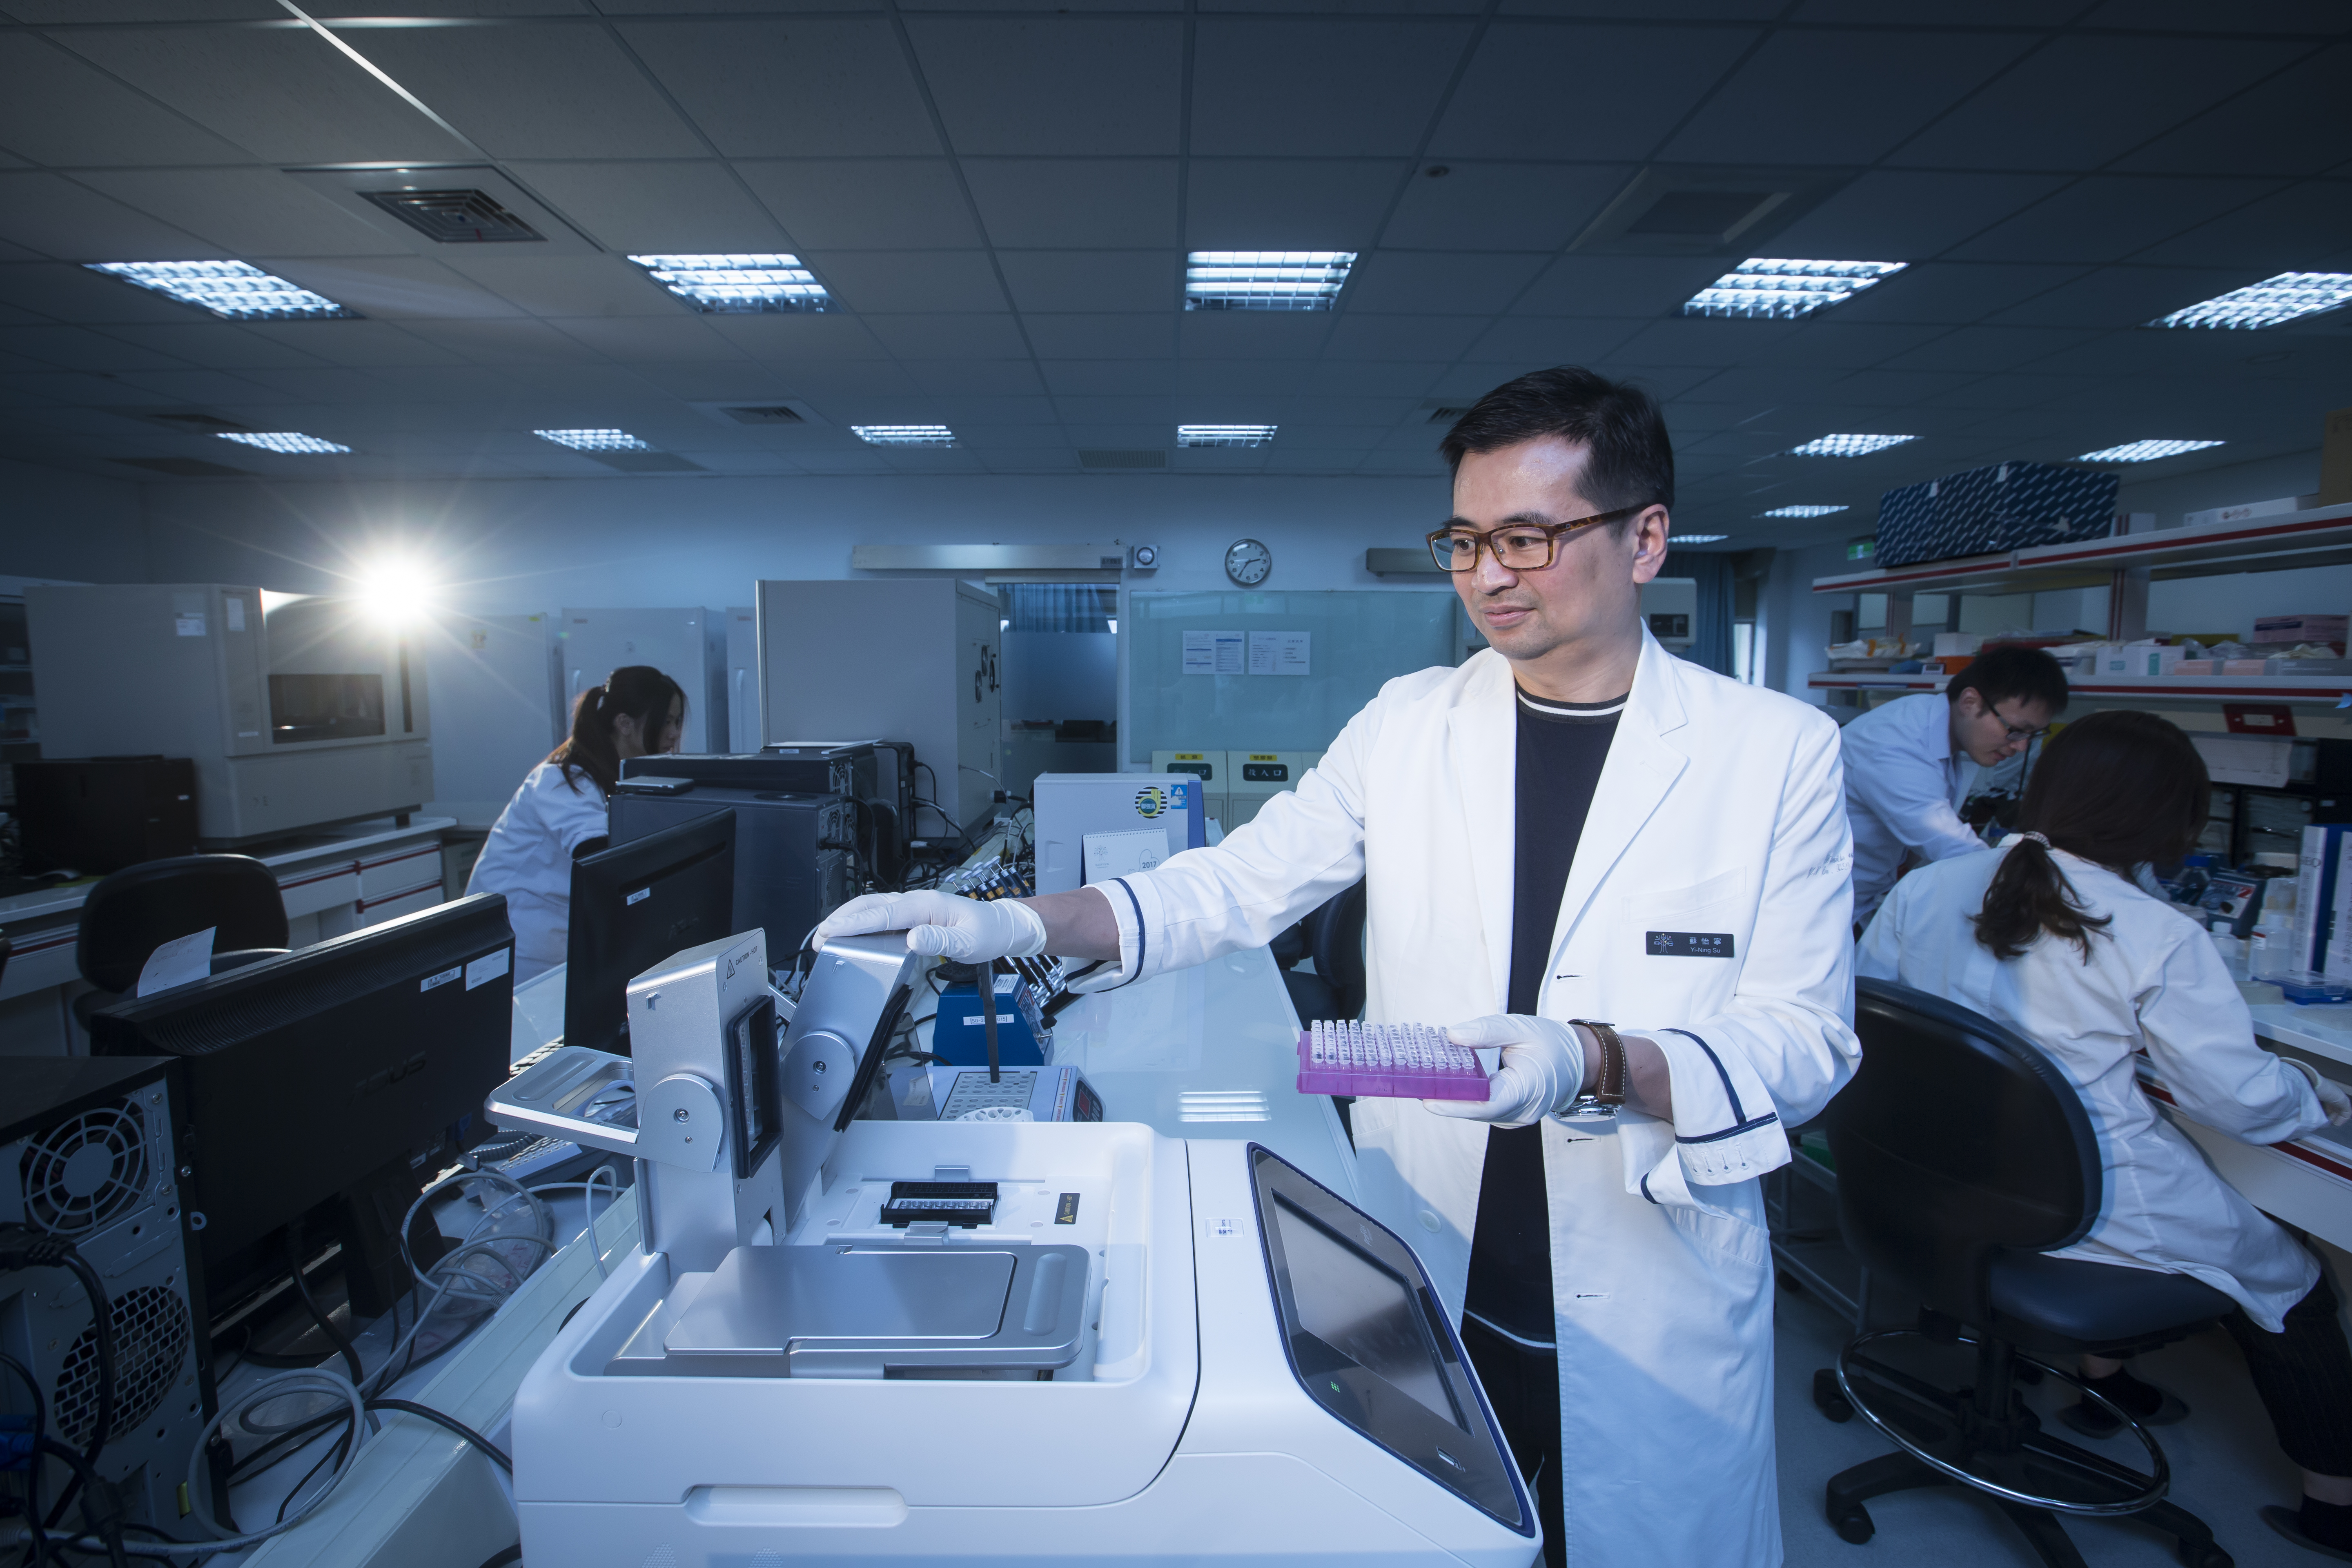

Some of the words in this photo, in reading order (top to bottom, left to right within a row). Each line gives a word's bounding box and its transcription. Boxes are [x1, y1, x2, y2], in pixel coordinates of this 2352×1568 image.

[1248, 768, 1282, 777] 投入口
[1142, 861, 1157, 869] 2017
[1689, 937, 1722, 946] 蘇怡寧
[735, 951, 750, 966] CAUTION
